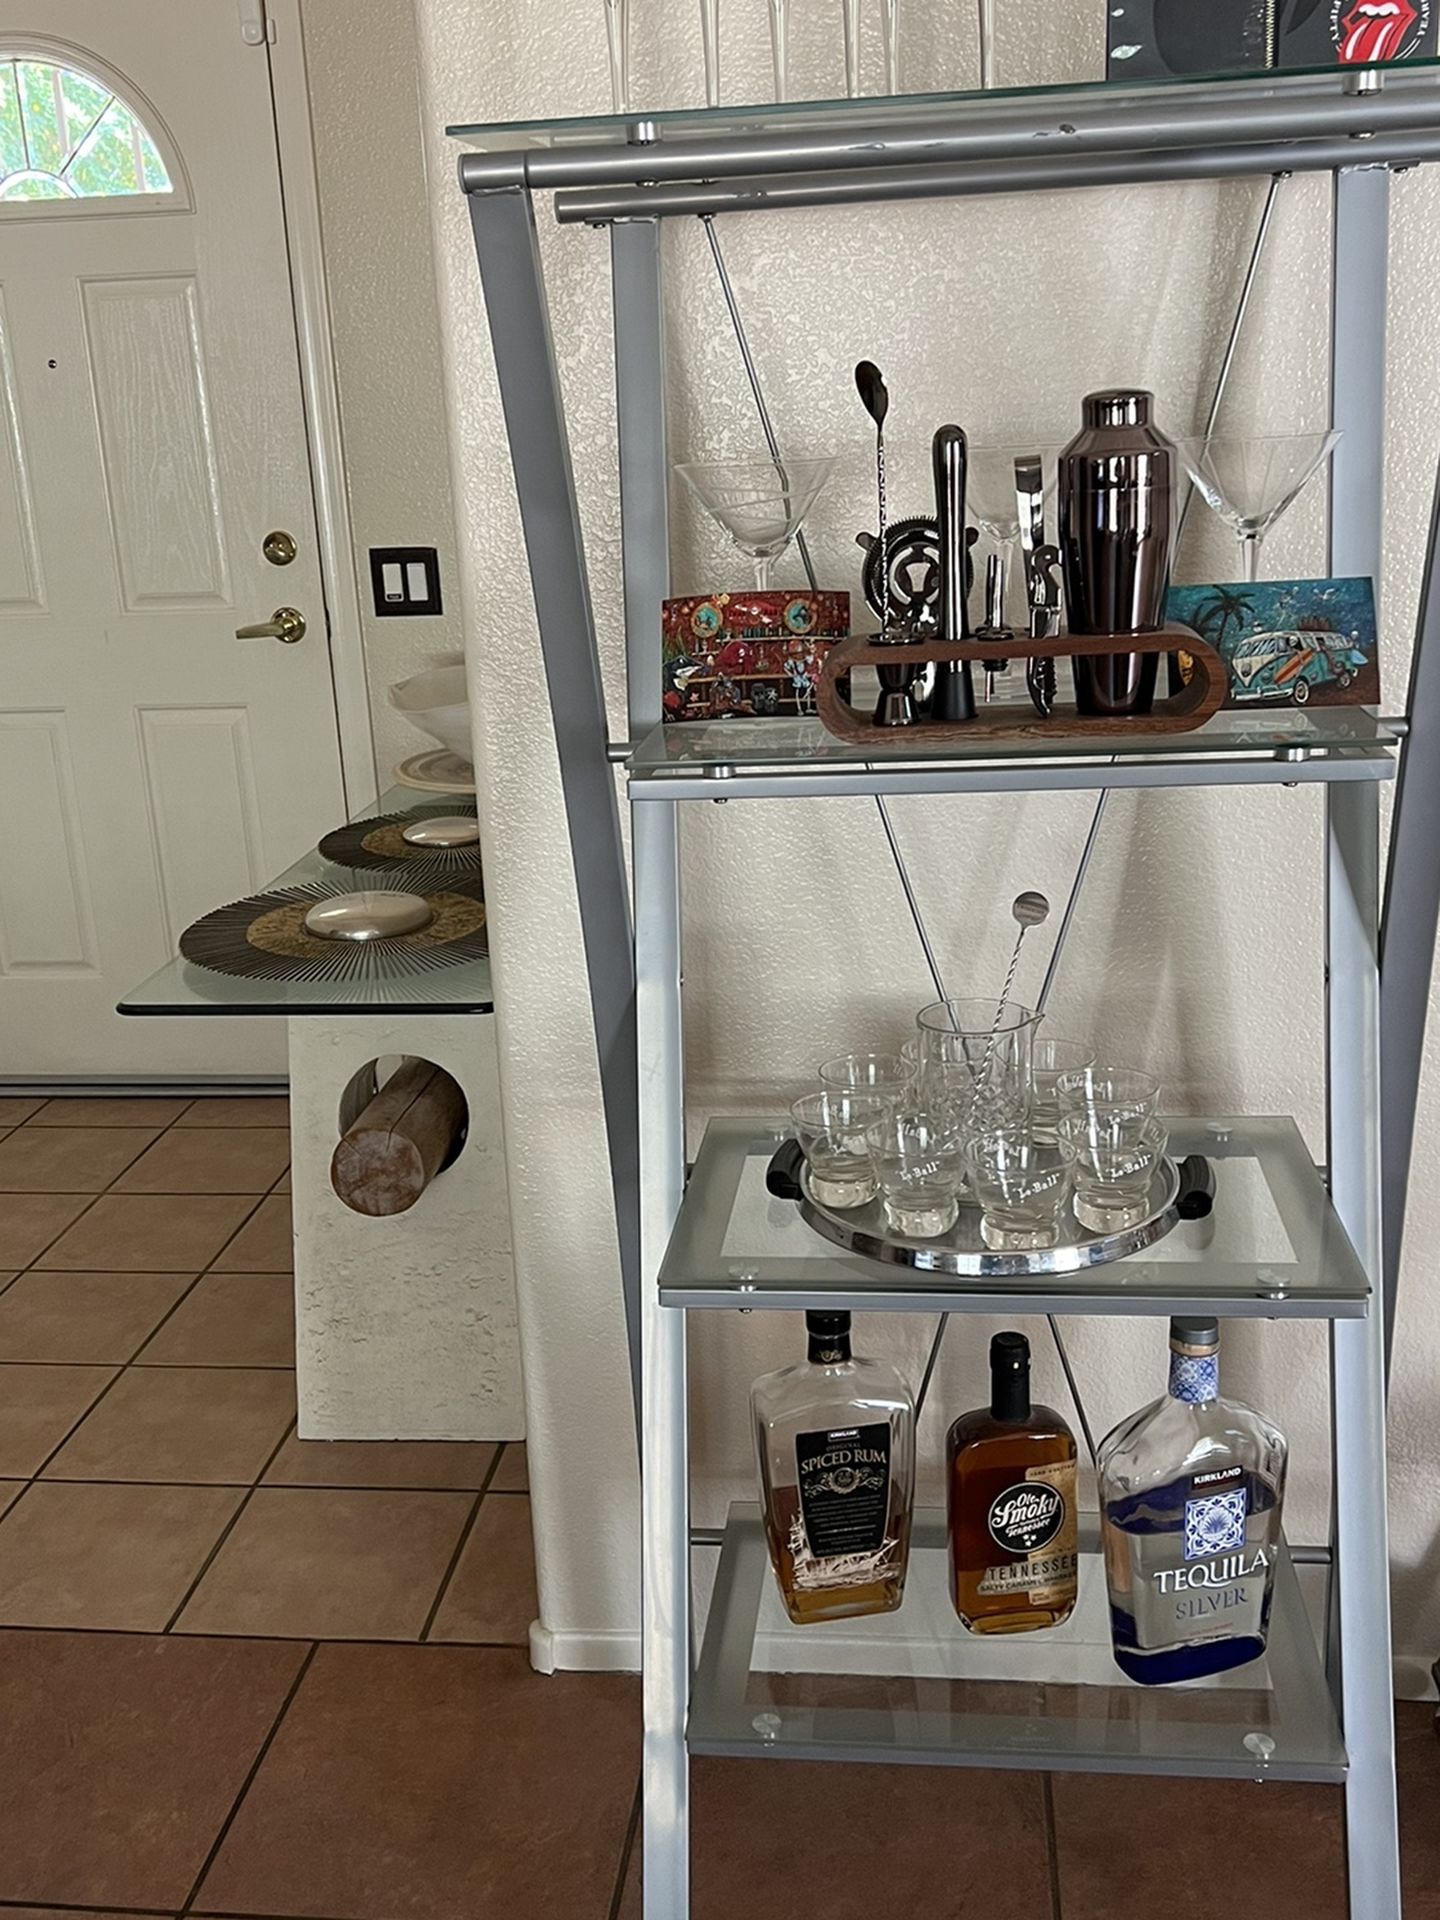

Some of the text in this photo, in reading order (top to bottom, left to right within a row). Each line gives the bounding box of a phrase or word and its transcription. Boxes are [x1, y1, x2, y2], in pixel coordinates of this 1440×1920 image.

[801, 1449, 887, 1475] SPICED RUM
[1194, 1467, 1241, 1484] KIRKLAND
[991, 1494, 1060, 1528] Smoky
[1017, 1493, 1040, 1507] Ole
[1005, 1518, 1051, 1538] Tennessee
[988, 1553, 1078, 1580] TENNESSEE
[1153, 1548, 1269, 1593] TEQUILA
[1175, 1588, 1248, 1620] SILVER
